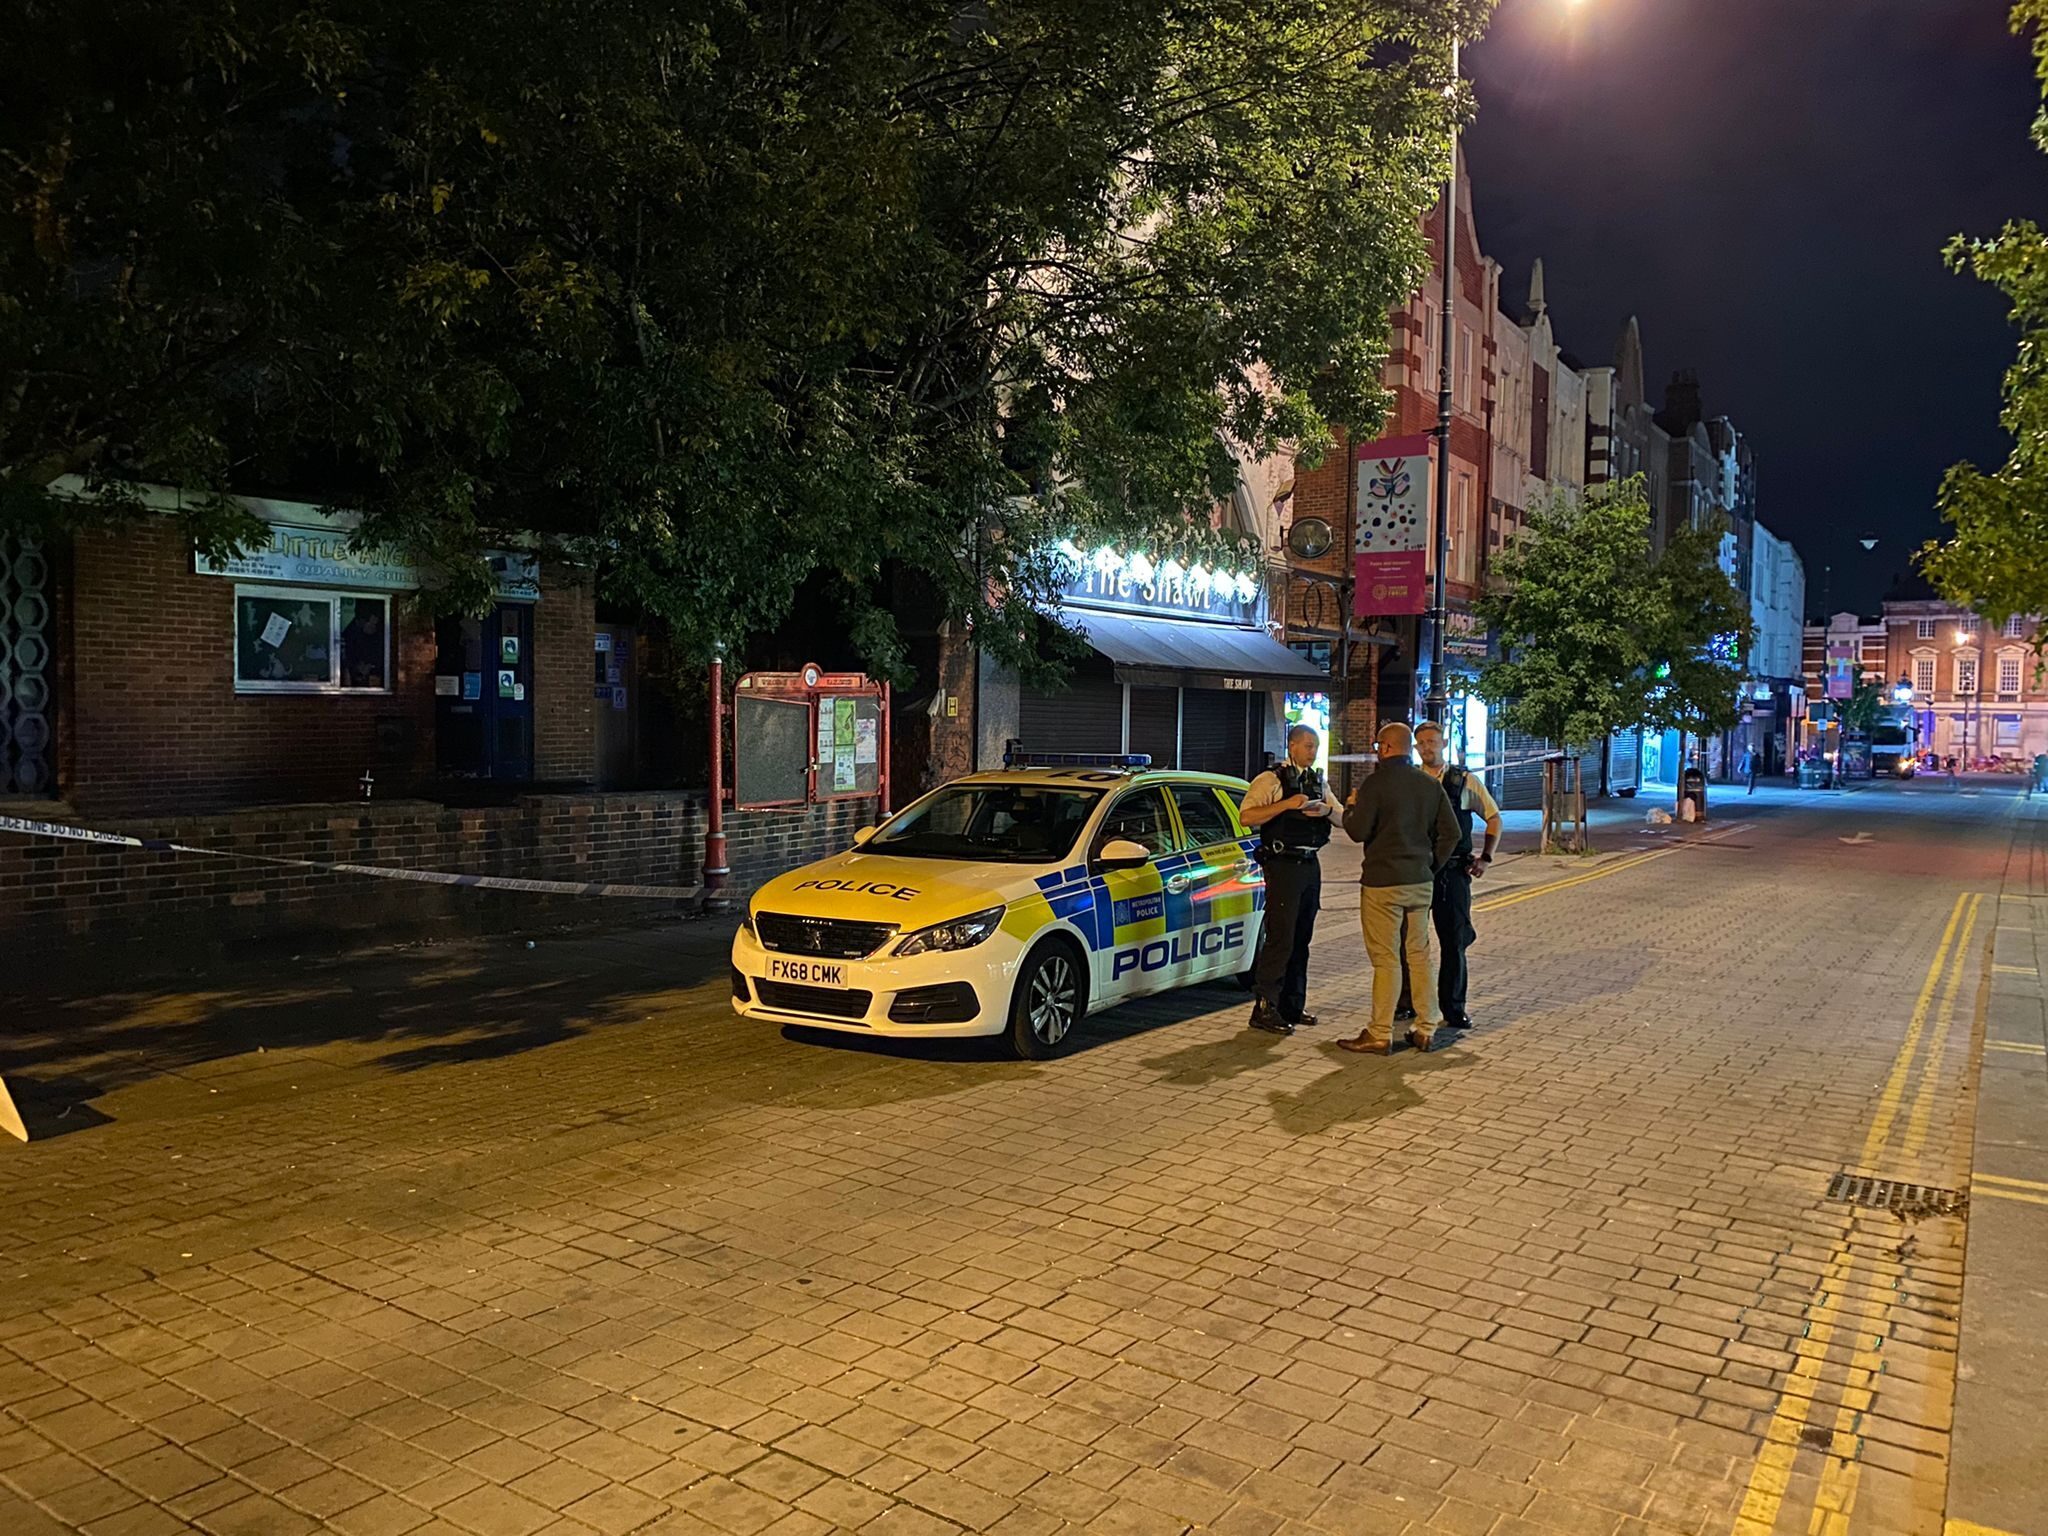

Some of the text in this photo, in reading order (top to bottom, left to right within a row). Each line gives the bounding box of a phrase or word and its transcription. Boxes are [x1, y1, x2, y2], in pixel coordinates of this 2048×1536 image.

[268, 532, 347, 561] LITTLE
[296, 564, 371, 579] QUALITY
[23, 820, 48, 832] LINE
[51, 824, 66, 836] DO
[793, 879, 921, 901] POLICE
[1136, 906, 1159, 918] POLICE
[1112, 921, 1244, 981] POLICE
[772, 960, 841, 984] FX68 CMK
